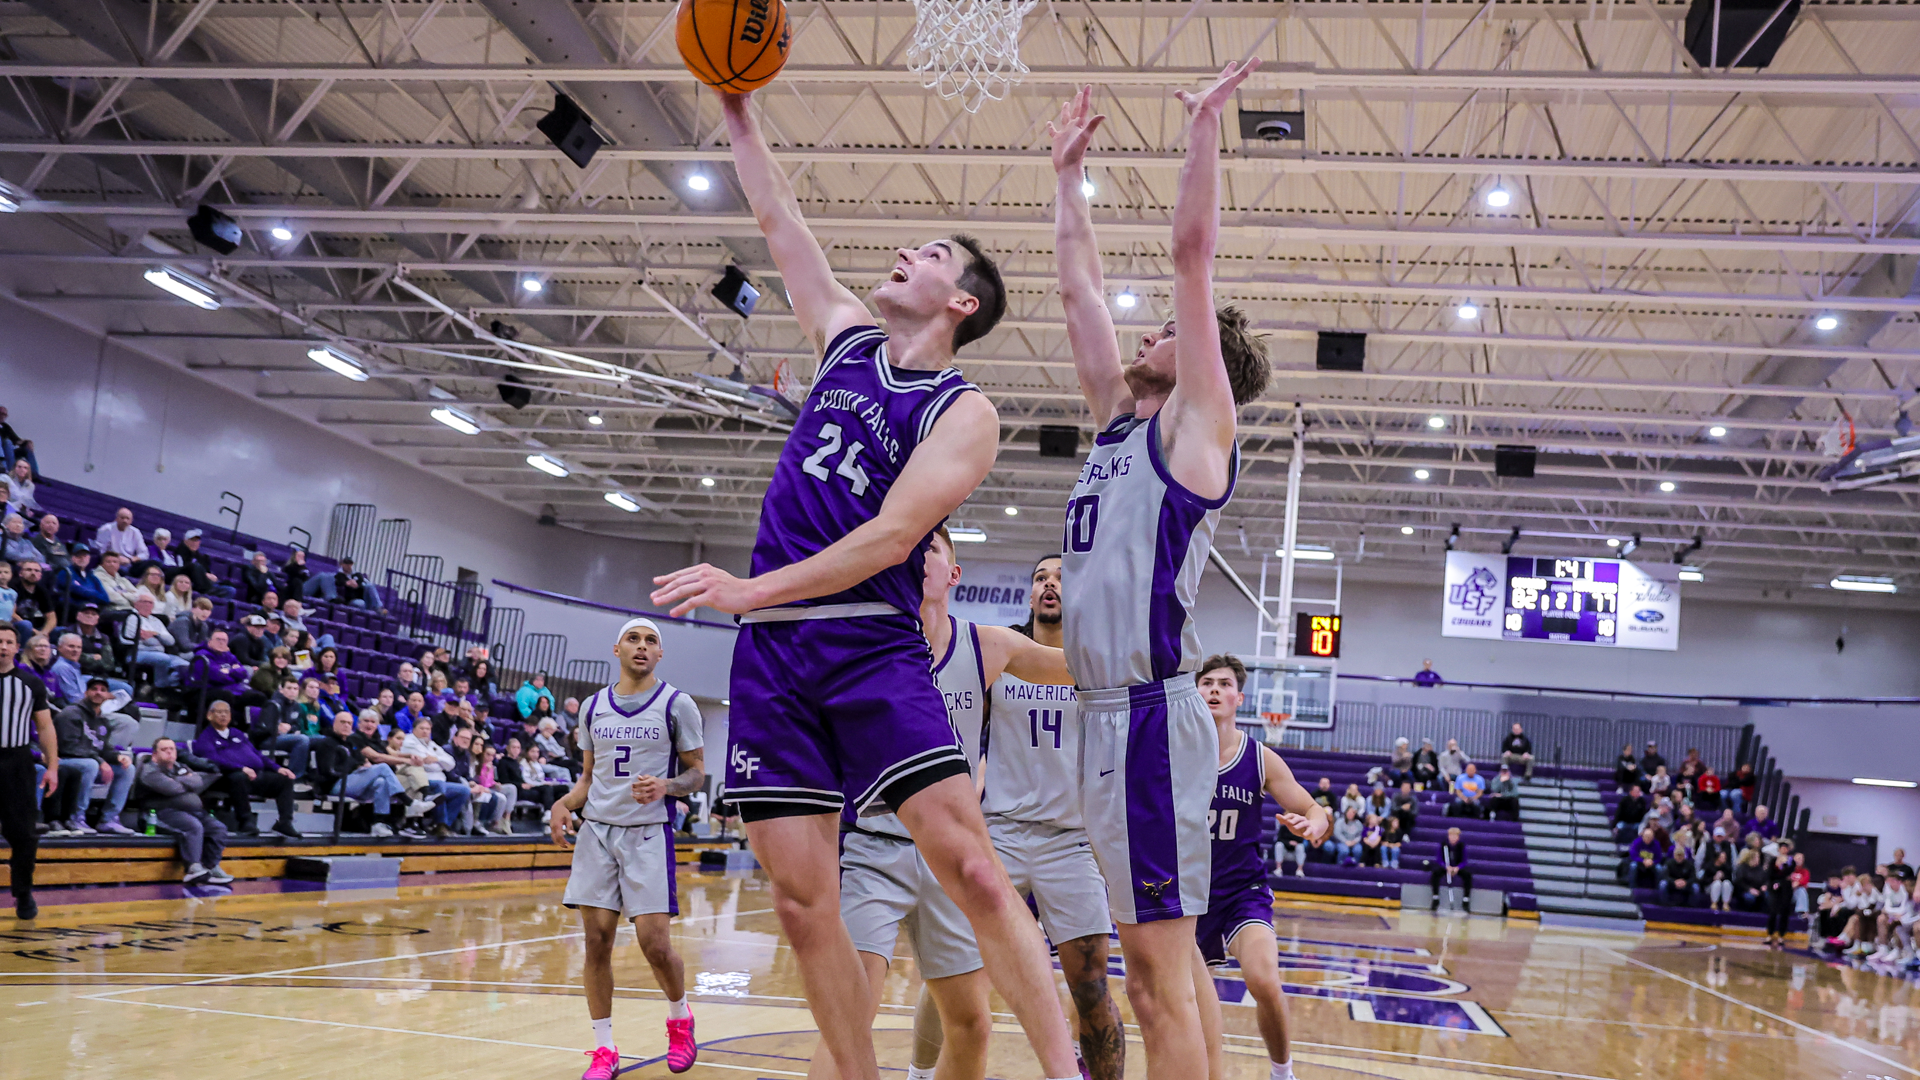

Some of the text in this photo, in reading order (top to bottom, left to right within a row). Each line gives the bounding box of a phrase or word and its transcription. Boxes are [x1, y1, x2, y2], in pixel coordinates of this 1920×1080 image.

[814, 389, 900, 464] SIOUX FALLS
[802, 422, 870, 497] 24
[955, 585, 1025, 605] COUGAR
[1449, 584, 1497, 616] USF
[1592, 593, 1616, 613] 77
[1311, 630, 1333, 656] 10
[594, 726, 660, 740] MAVERICKS
[1028, 709, 1063, 750] 14
[613, 744, 632, 778] 2
[731, 743, 760, 780] USF
[1222, 784, 1254, 805] FALLS
[1207, 809, 1239, 841] 20
